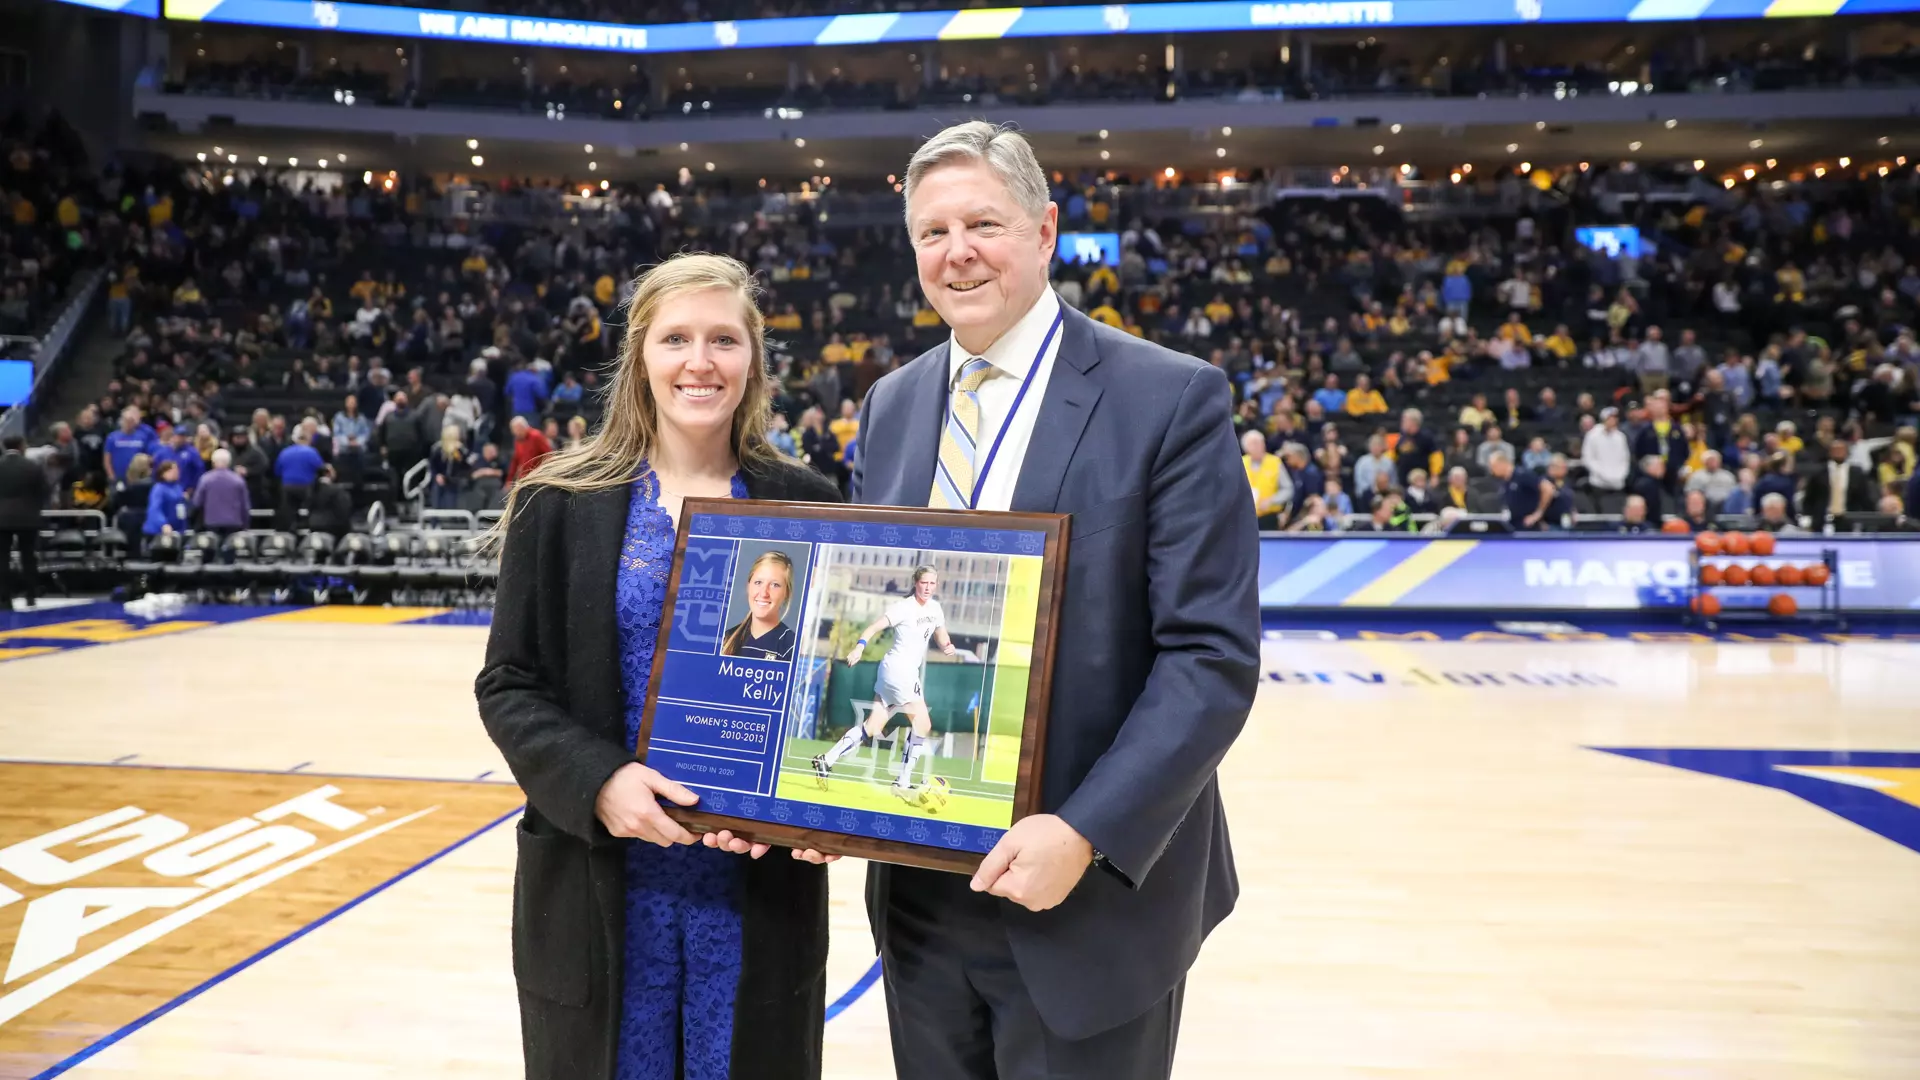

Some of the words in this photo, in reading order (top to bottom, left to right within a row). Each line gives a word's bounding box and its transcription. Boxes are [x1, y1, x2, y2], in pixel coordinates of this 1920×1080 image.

[1250, 1, 1394, 25] MARQUETTE
[419, 13, 456, 35] WE
[459, 16, 507, 39] ARE
[511, 20, 647, 48] MARQUETTE
[1523, 558, 1876, 588] MARQE
[677, 588, 731, 599] RQUE
[718, 660, 785, 683] Maegan
[742, 683, 782, 706] Kelly
[685, 714, 728, 728] WOMEN'S
[731, 720, 766, 732] SOCCER
[720, 730, 764, 743] 2010-2013
[676, 762, 707, 773] INDUCTED
[718, 768, 735, 776] 2020
[3, 784, 368, 984] AST
